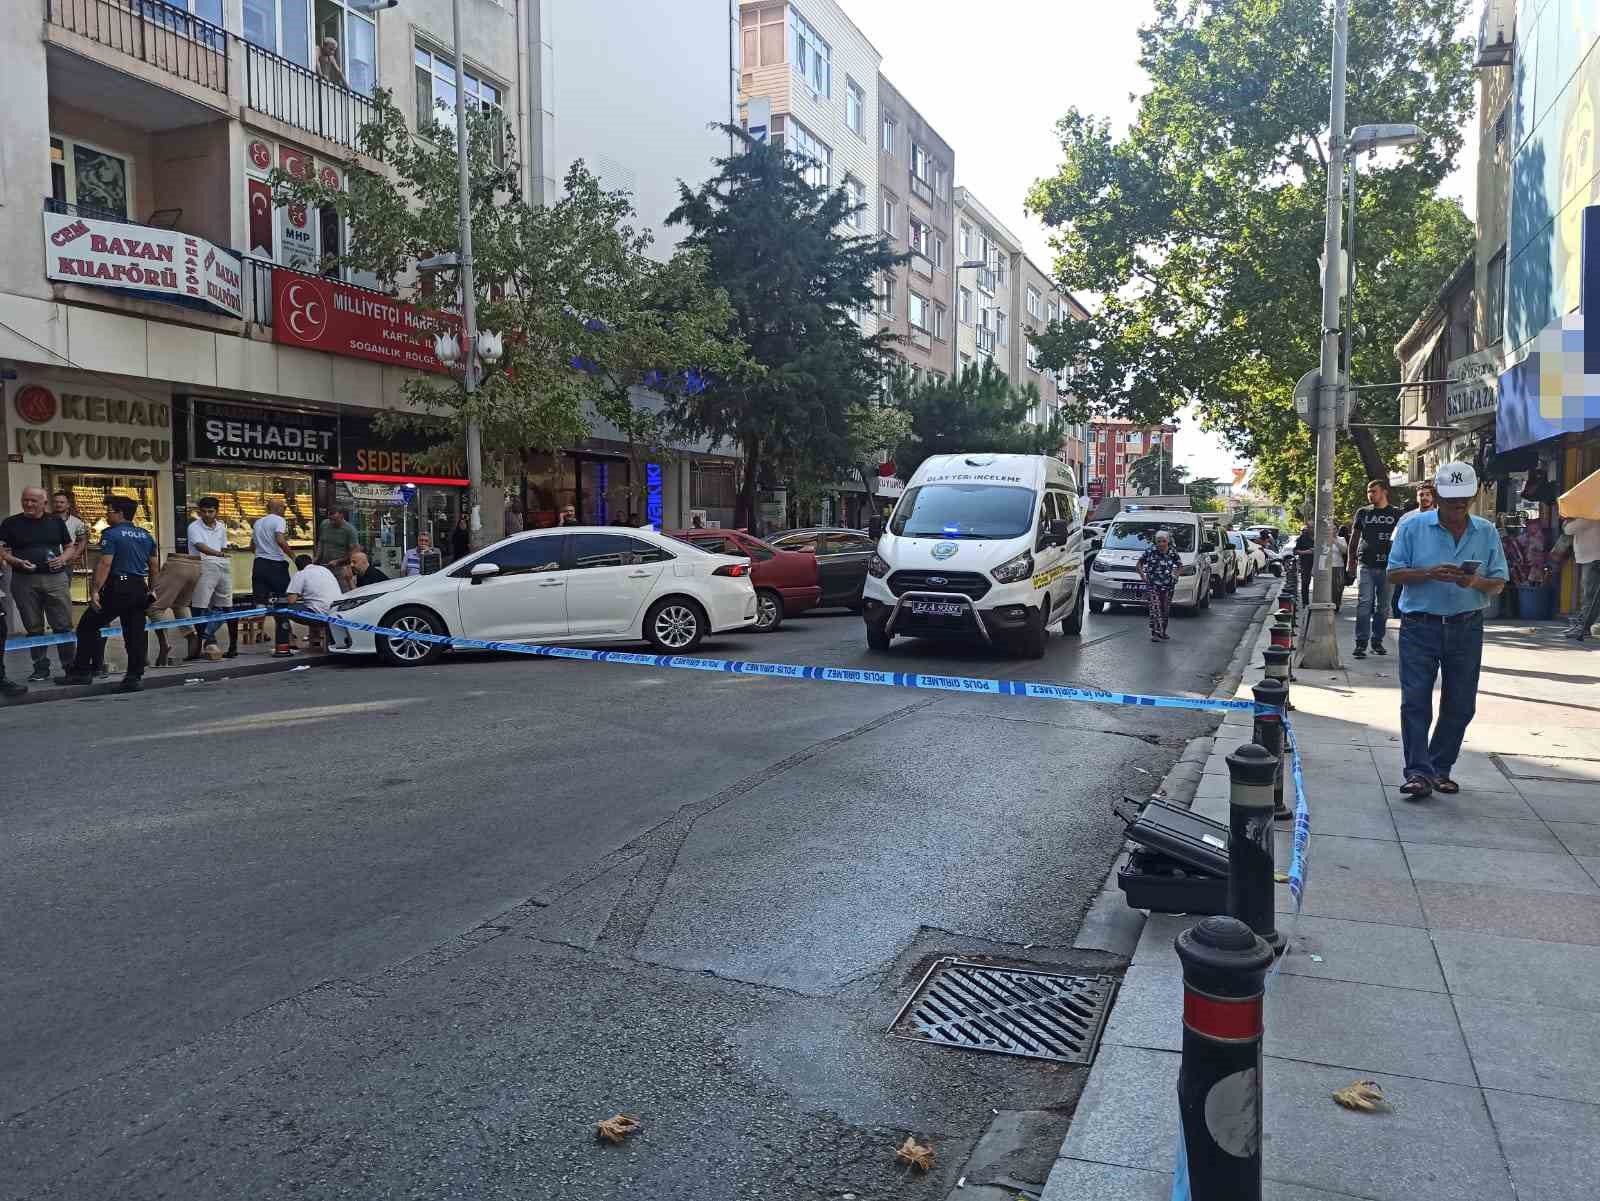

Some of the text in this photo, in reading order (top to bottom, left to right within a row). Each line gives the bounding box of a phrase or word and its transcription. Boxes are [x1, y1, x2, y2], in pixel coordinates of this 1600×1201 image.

[51, 220, 90, 247] CEM
[286, 228, 310, 242] MHP
[90, 235, 174, 262] BAYAN
[58, 257, 178, 288] KUAFÖRÜ
[383, 329, 421, 346] KARTAL
[61, 394, 169, 428] KENAN
[15, 428, 170, 464] KUYUMCU
[206, 419, 334, 450] ŞEHADET
[217, 445, 327, 464] KUYUMCULUK
